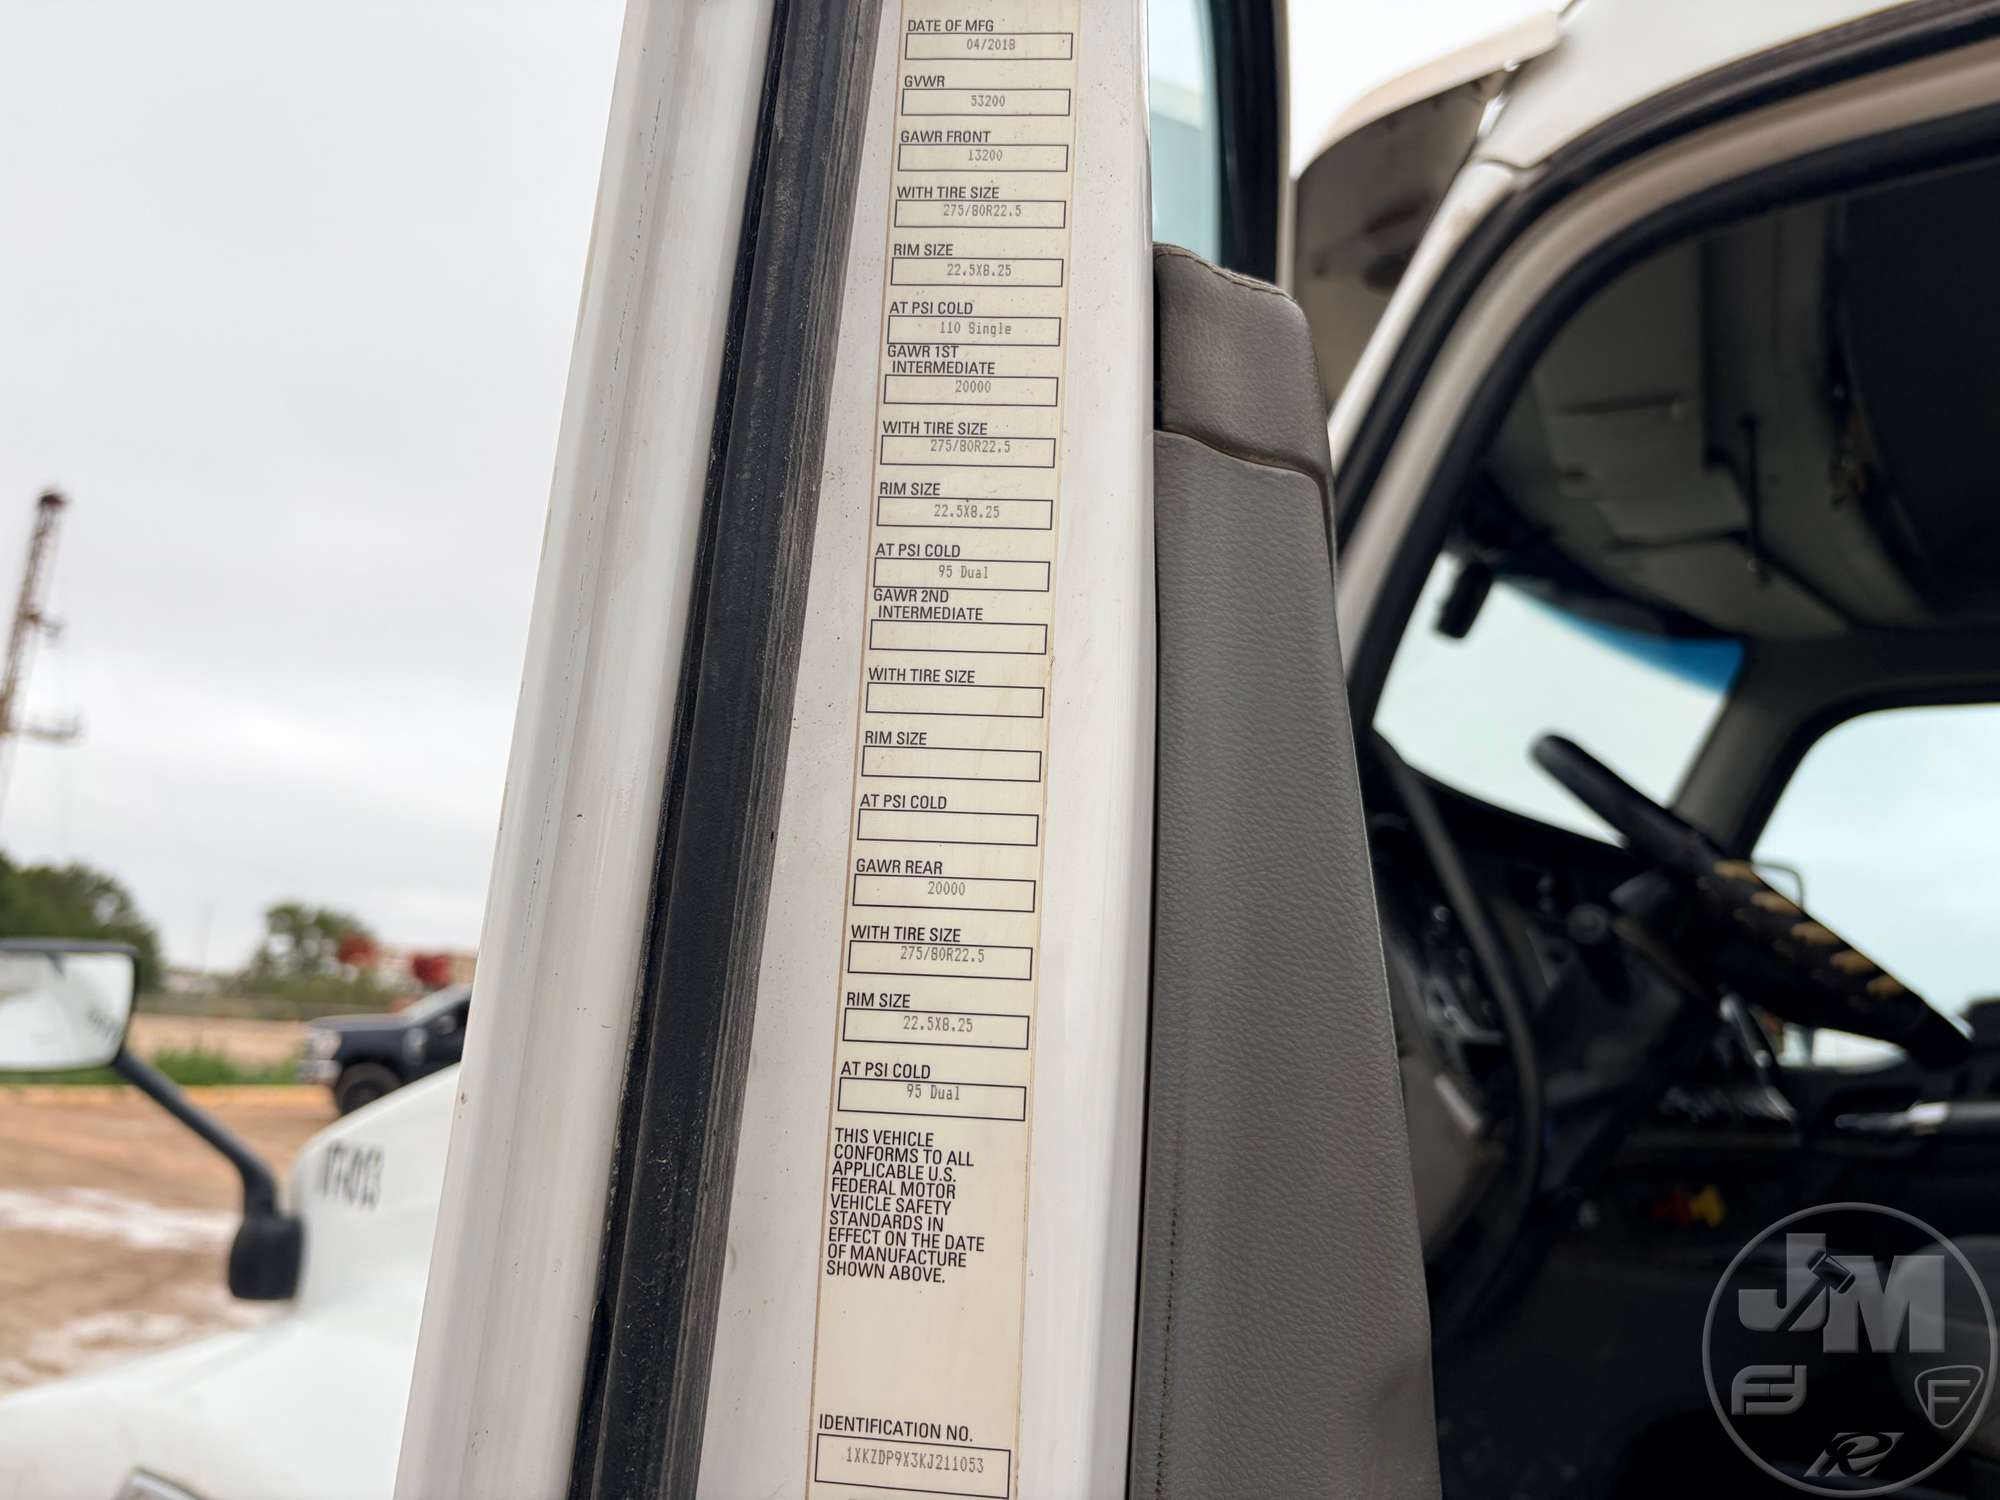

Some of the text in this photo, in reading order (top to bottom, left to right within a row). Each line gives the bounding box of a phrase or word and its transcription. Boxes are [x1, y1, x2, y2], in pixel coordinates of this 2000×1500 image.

[907, 19, 994, 32] DATE OF MFG
[966, 38, 1016, 51] 04/2018
[904, 75, 945, 88] GVWR
[970, 95, 1006, 107] 53200
[900, 130, 991, 143] GAWR FRONT
[968, 150, 1003, 162] 13200
[896, 186, 1000, 199] WITH TIRE SIZE
[943, 204, 1022, 217] 275/80R22.5
[893, 243, 954, 257] RIM SIZE
[947, 264, 1012, 277] 22.5X8.25
[889, 301, 973, 315] AT PSI COLD
[940, 321, 1012, 338] 110 Single
[887, 345, 959, 358] GAWR 1ST
[892, 360, 996, 375] INTERMEDIATE
[955, 380, 991, 393] 20000
[882, 420, 988, 435] WITH TIRE SIZE
[930, 439, 1011, 454] 275/80R22.5
[880, 482, 941, 496] RIM SIZE
[934, 504, 1000, 518] 22.5X8.25
[875, 543, 961, 558] AT PSI COLD
[938, 564, 989, 579] 95 Dual
[873, 588, 949, 603] GAWR 2ND
[878, 605, 984, 621] INTERMEDIATE
[868, 667, 976, 684] WITH TIRE SIZE
[864, 730, 927, 746] RIM SIZE
[860, 794, 947, 810] AT PSI COLD
[856, 858, 943, 875] GAWR REAR
[928, 880, 966, 896] 20000
[851, 924, 961, 943] WITH TIRE SIZE
[900, 945, 985, 963] 275/80R22.5
[846, 991, 911, 1009] RIM SIZE
[903, 1015, 974, 1032] 22.5X8.25
[840, 1061, 931, 1079] AT PSI COLD
[906, 1083, 960, 1100] 95 Dual
[835, 1127, 934, 1148] THIS VEHICLE
[834, 1144, 974, 1167] CONFORMS TO ALL
[832, 1160, 957, 1183] APPLICABLE U.S.
[831, 1177, 956, 1199] FEDERAL MOTOR
[830, 1193, 952, 1216] VEHICLE SAFETY
[829, 1210, 944, 1232] STANDARDS IN
[828, 1226, 985, 1252] EFFECT ON THE DATE
[827, 1243, 967, 1268] OF MANUFACTURE
[826, 1260, 946, 1283] SHOWN ABOVE.
[819, 1413, 973, 1442] IDENTIFICATION NO.
